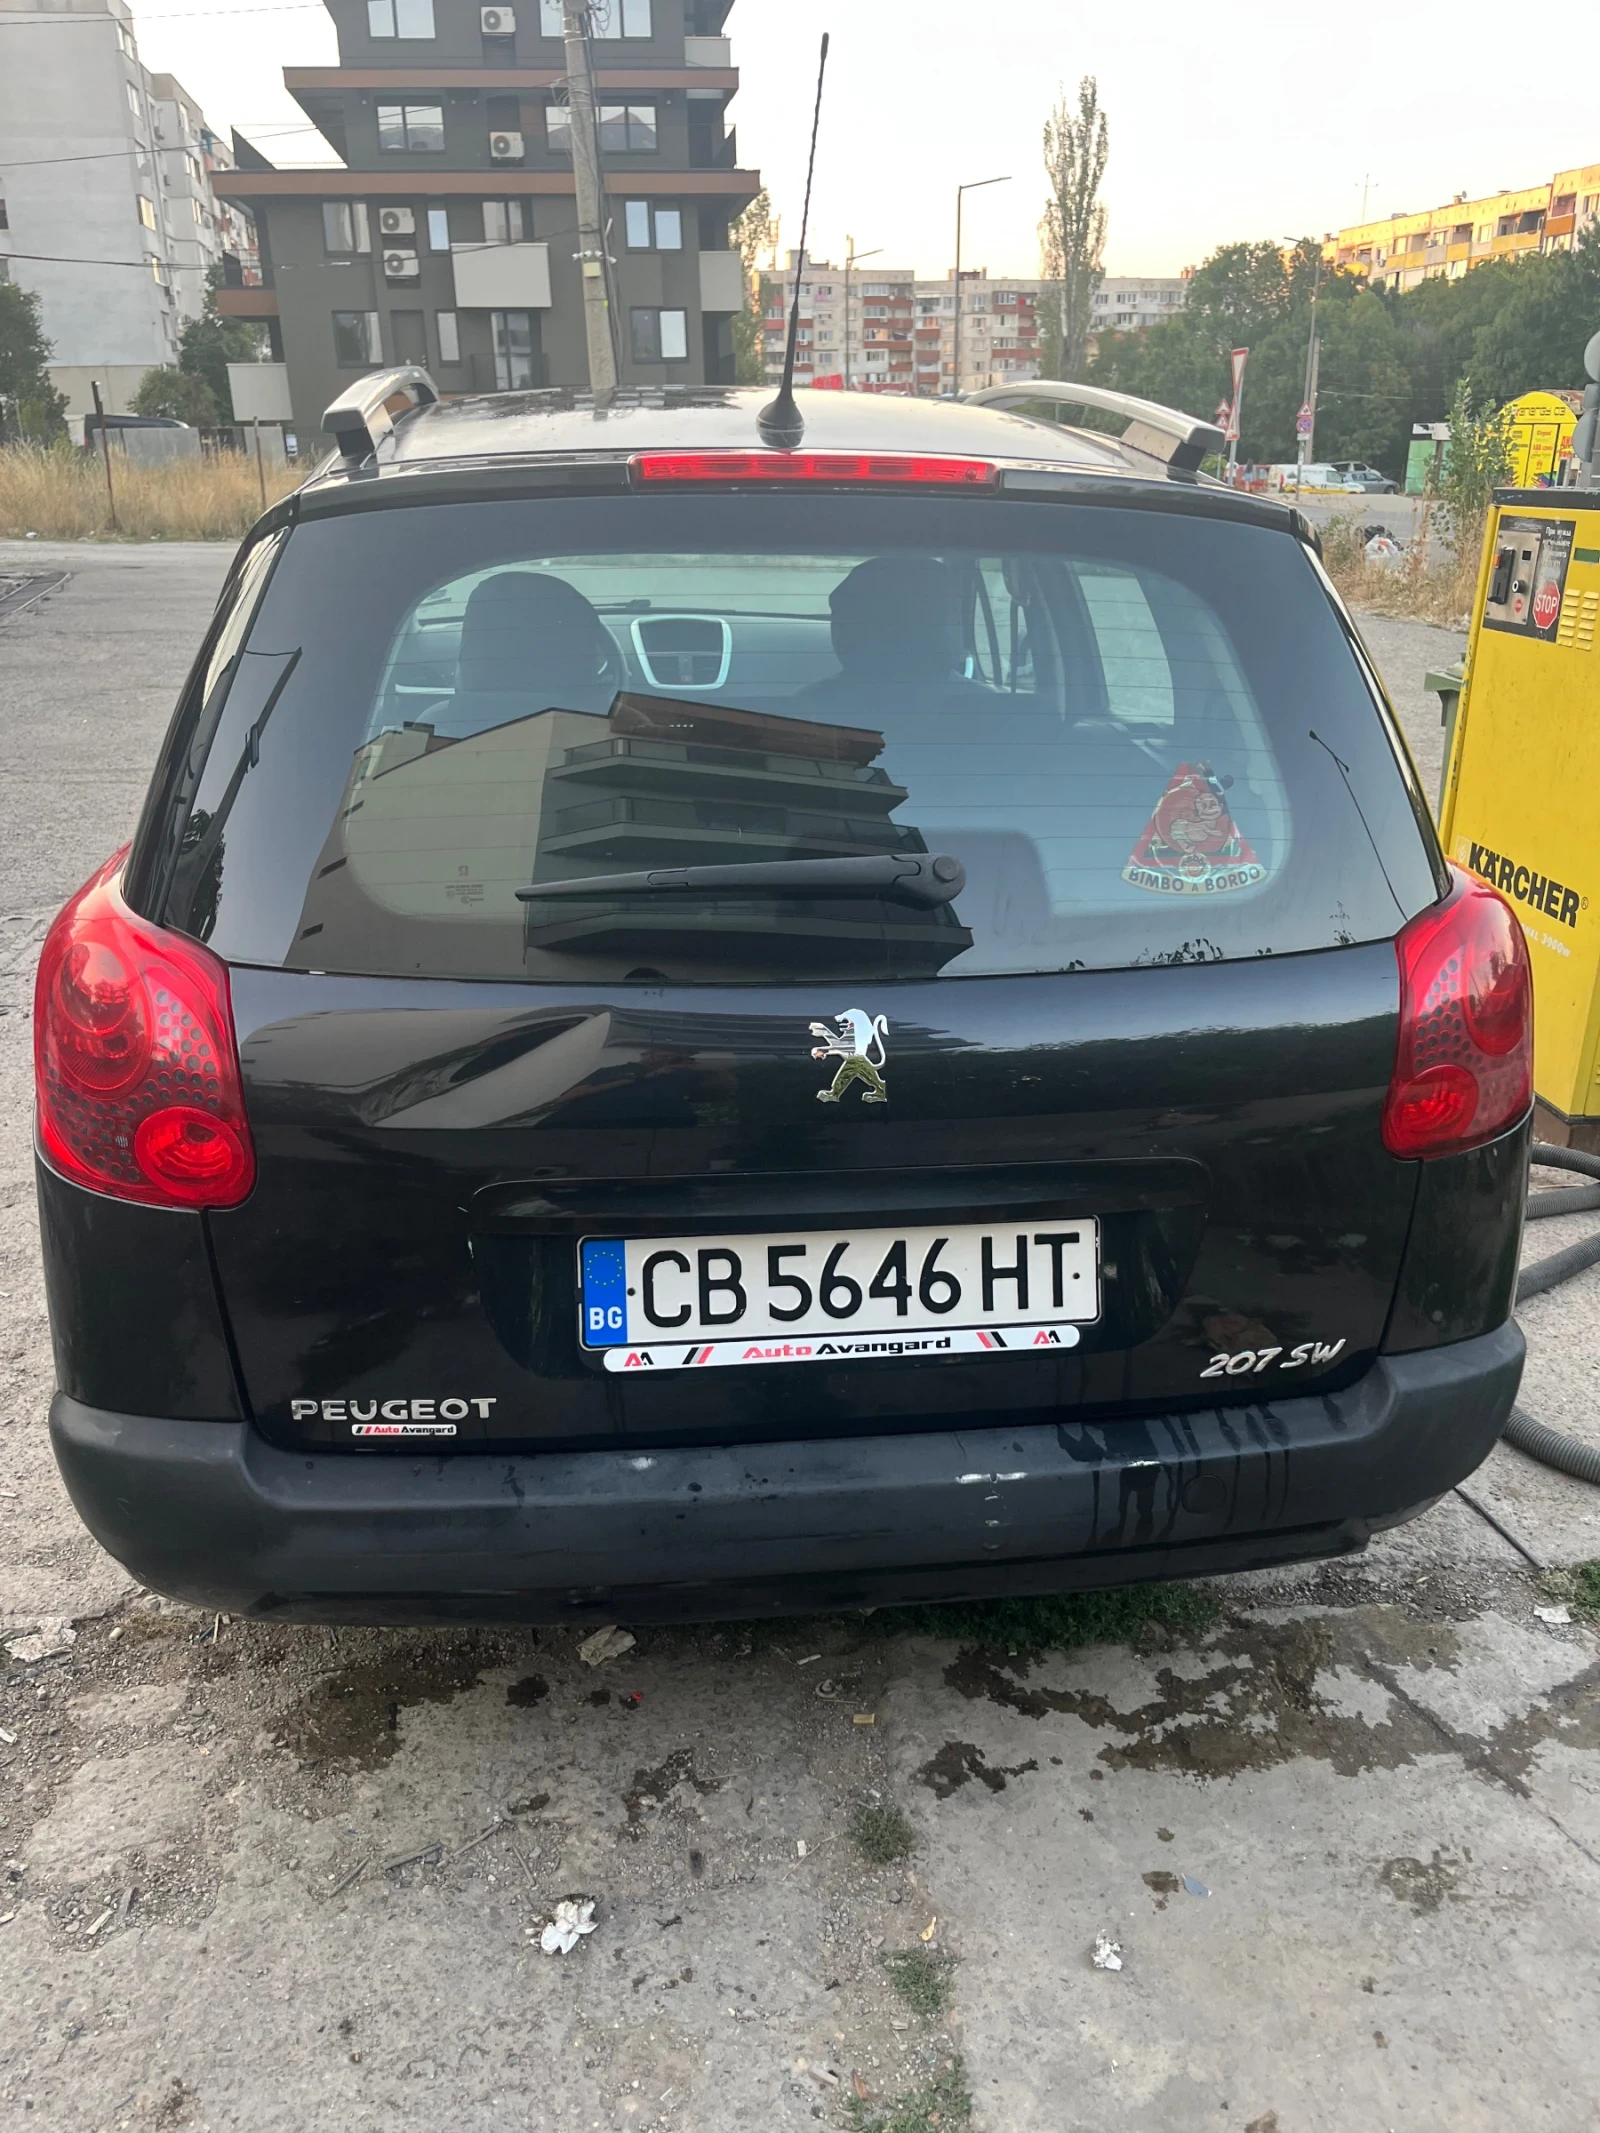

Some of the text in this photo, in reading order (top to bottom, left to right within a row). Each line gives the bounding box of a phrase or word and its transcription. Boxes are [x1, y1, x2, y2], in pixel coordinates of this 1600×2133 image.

[1535, 594, 1558, 614] STOP
[1128, 866, 1261, 892] BIMBO A BORDO
[1468, 841, 1580, 929] KÄRCHER
[642, 1232, 1080, 1328] CB 5646 HT
[589, 1306, 623, 1330] BG
[742, 1344, 812, 1359] Auto
[815, 1337, 951, 1355] Avangard
[1200, 1338, 1346, 1378] 207 SW
[291, 1398, 497, 1421] PEUGEOT
[373, 1425, 454, 1435] Auto Avangard
